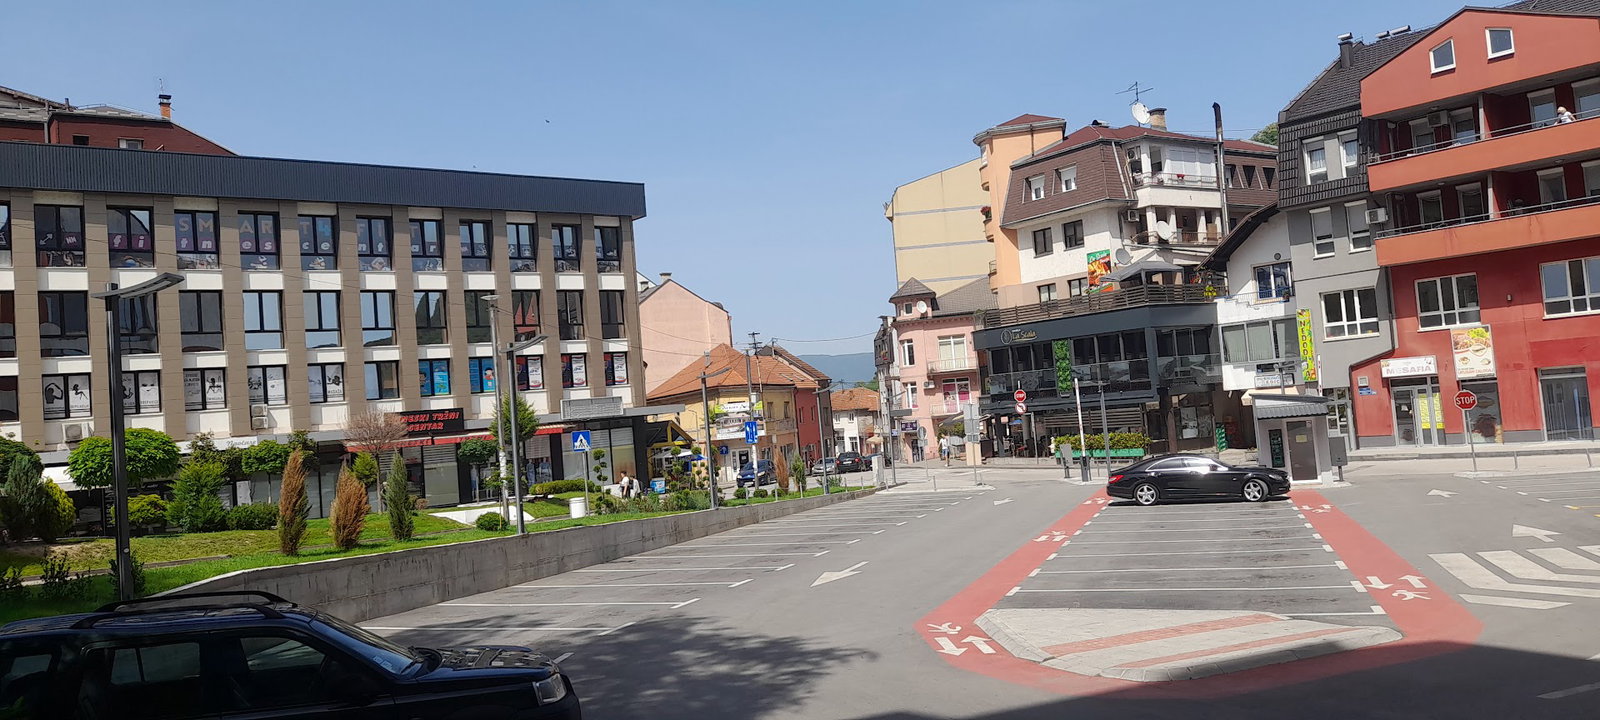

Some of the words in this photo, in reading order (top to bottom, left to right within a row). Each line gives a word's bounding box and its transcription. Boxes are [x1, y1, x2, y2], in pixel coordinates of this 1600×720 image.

[1456, 396, 1475, 405] STOP
[432, 410, 460, 421] TRŽNI
[408, 422, 444, 431] CENTAR
